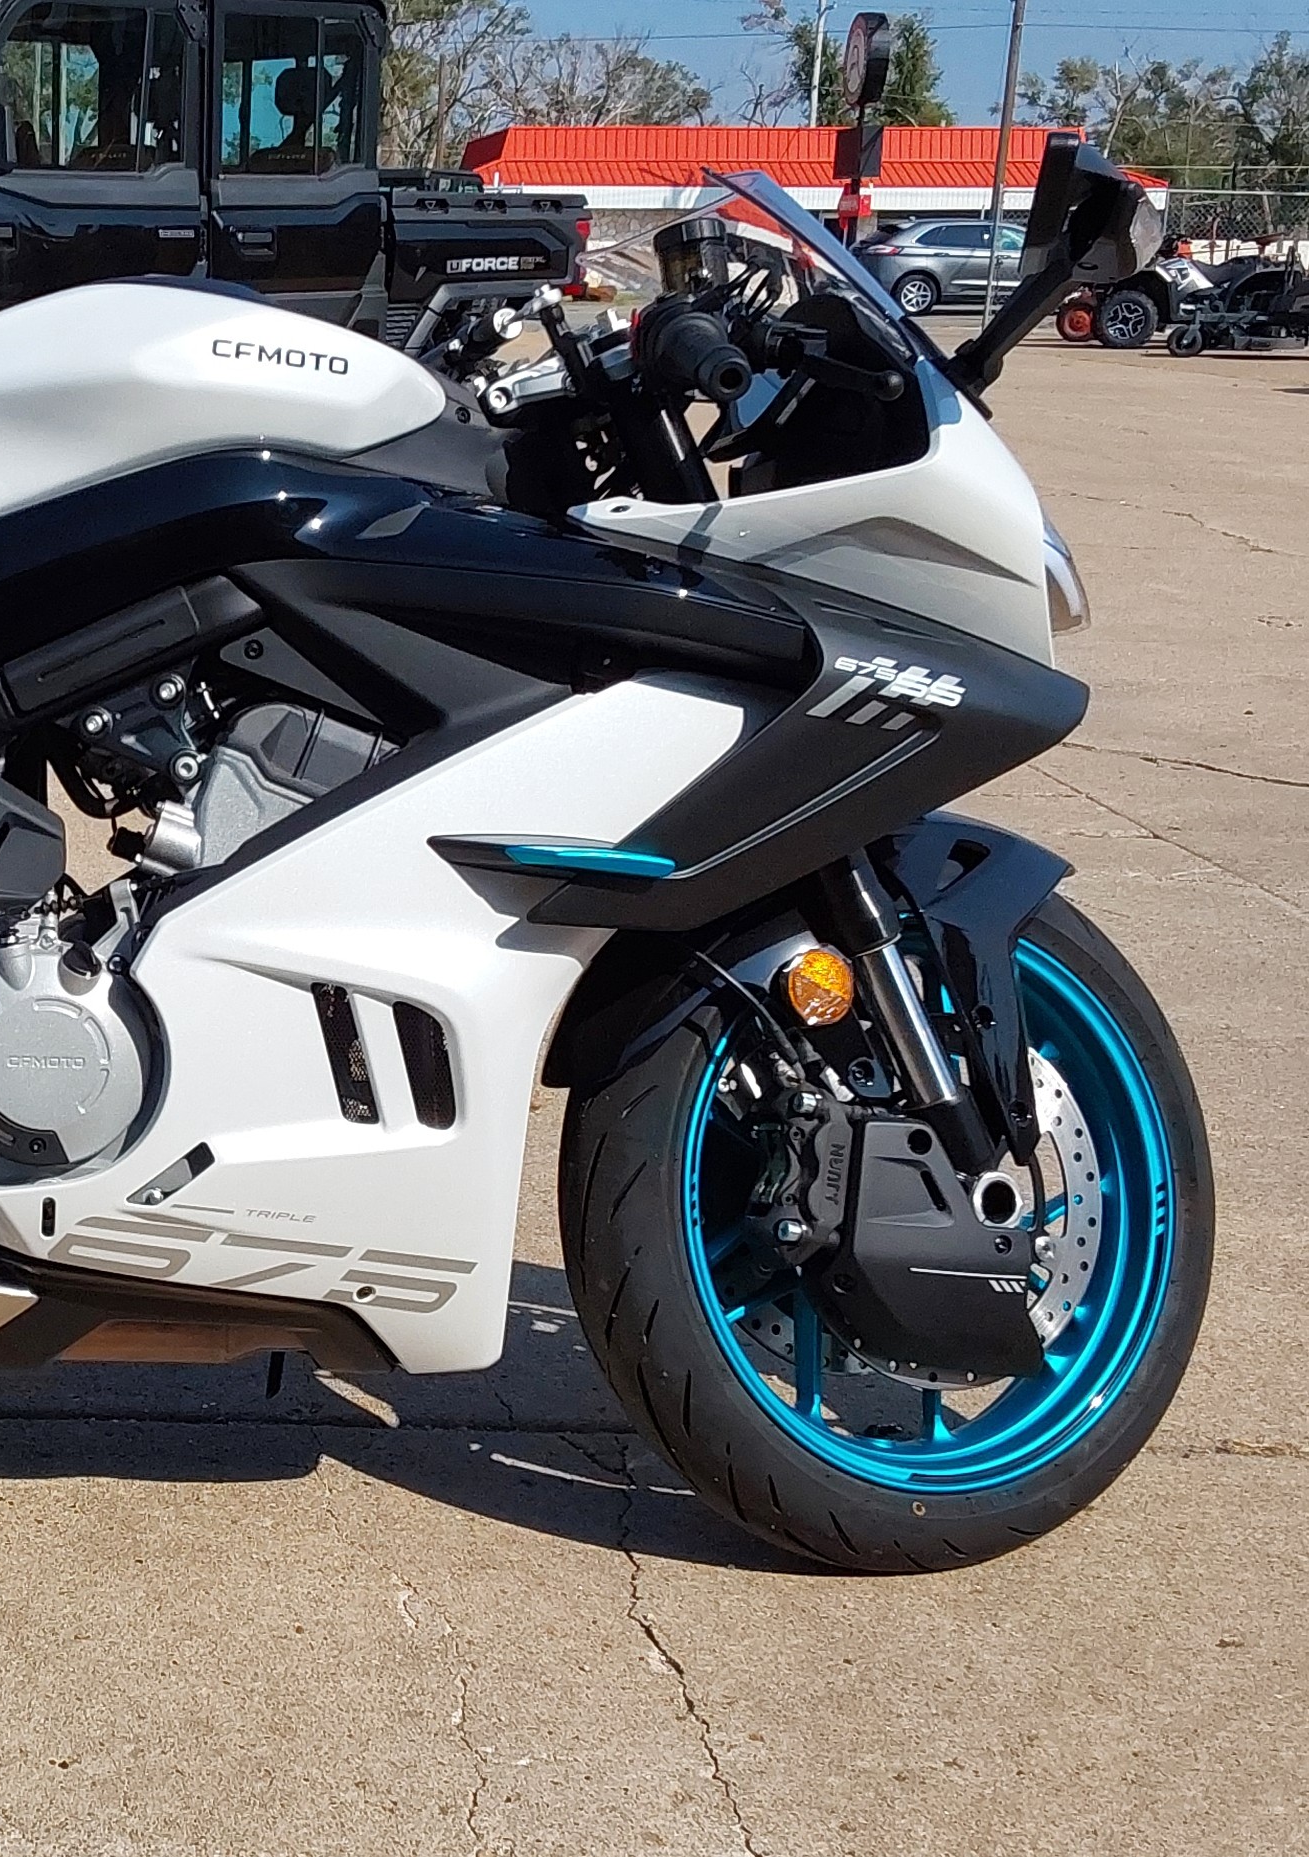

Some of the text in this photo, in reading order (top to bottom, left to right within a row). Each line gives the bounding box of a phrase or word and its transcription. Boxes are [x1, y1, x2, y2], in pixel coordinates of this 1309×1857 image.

[212, 339, 348, 375] CFMOTO
[6, 1056, 85, 1069] CFMOTO
[246, 1208, 317, 1223] TRIPLE
[47, 1215, 479, 1314] 675
